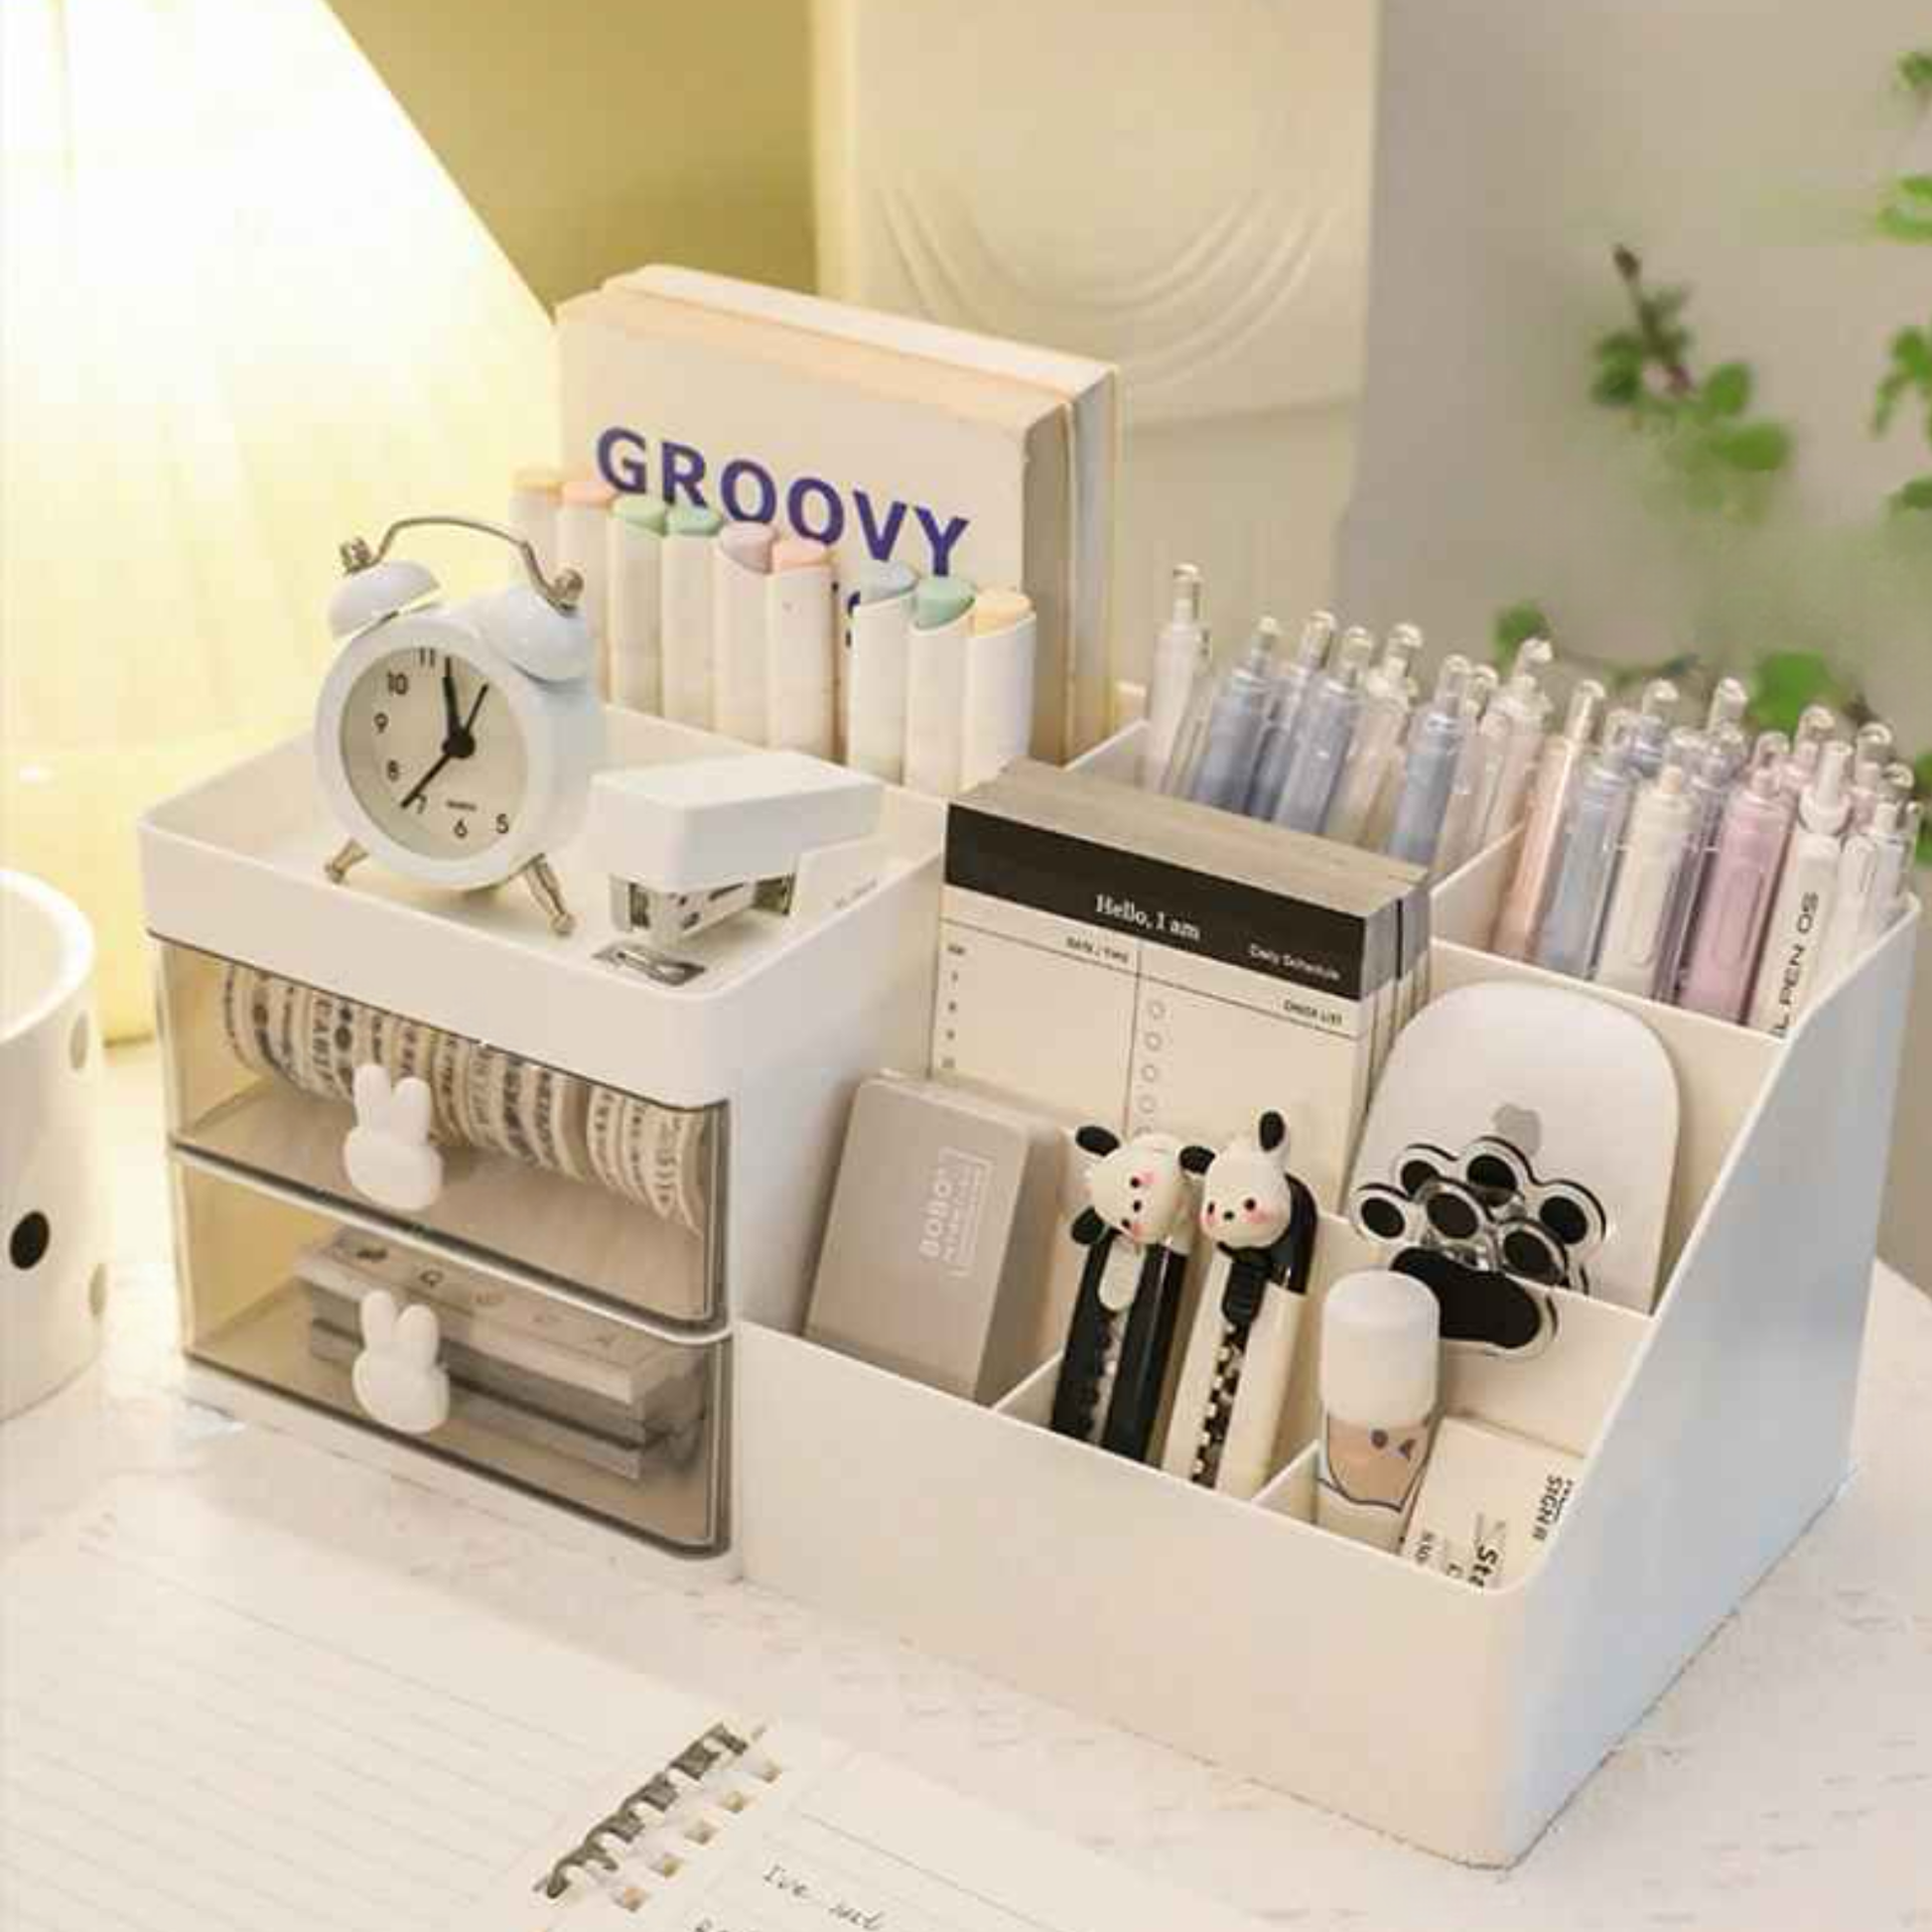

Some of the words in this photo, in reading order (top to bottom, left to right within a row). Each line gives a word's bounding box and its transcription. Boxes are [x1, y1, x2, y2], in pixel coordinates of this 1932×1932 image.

[597, 427, 970, 577] GROOVY
[387, 670, 409, 696] 10
[373, 713, 389, 734] 9
[386, 759, 400, 782] 8
[454, 818, 468, 838] 6
[495, 812, 509, 834] 5
[1095, 894, 1153, 930] Hello,
[1156, 910, 1165, 931] I
[1170, 918, 1201, 942] am
